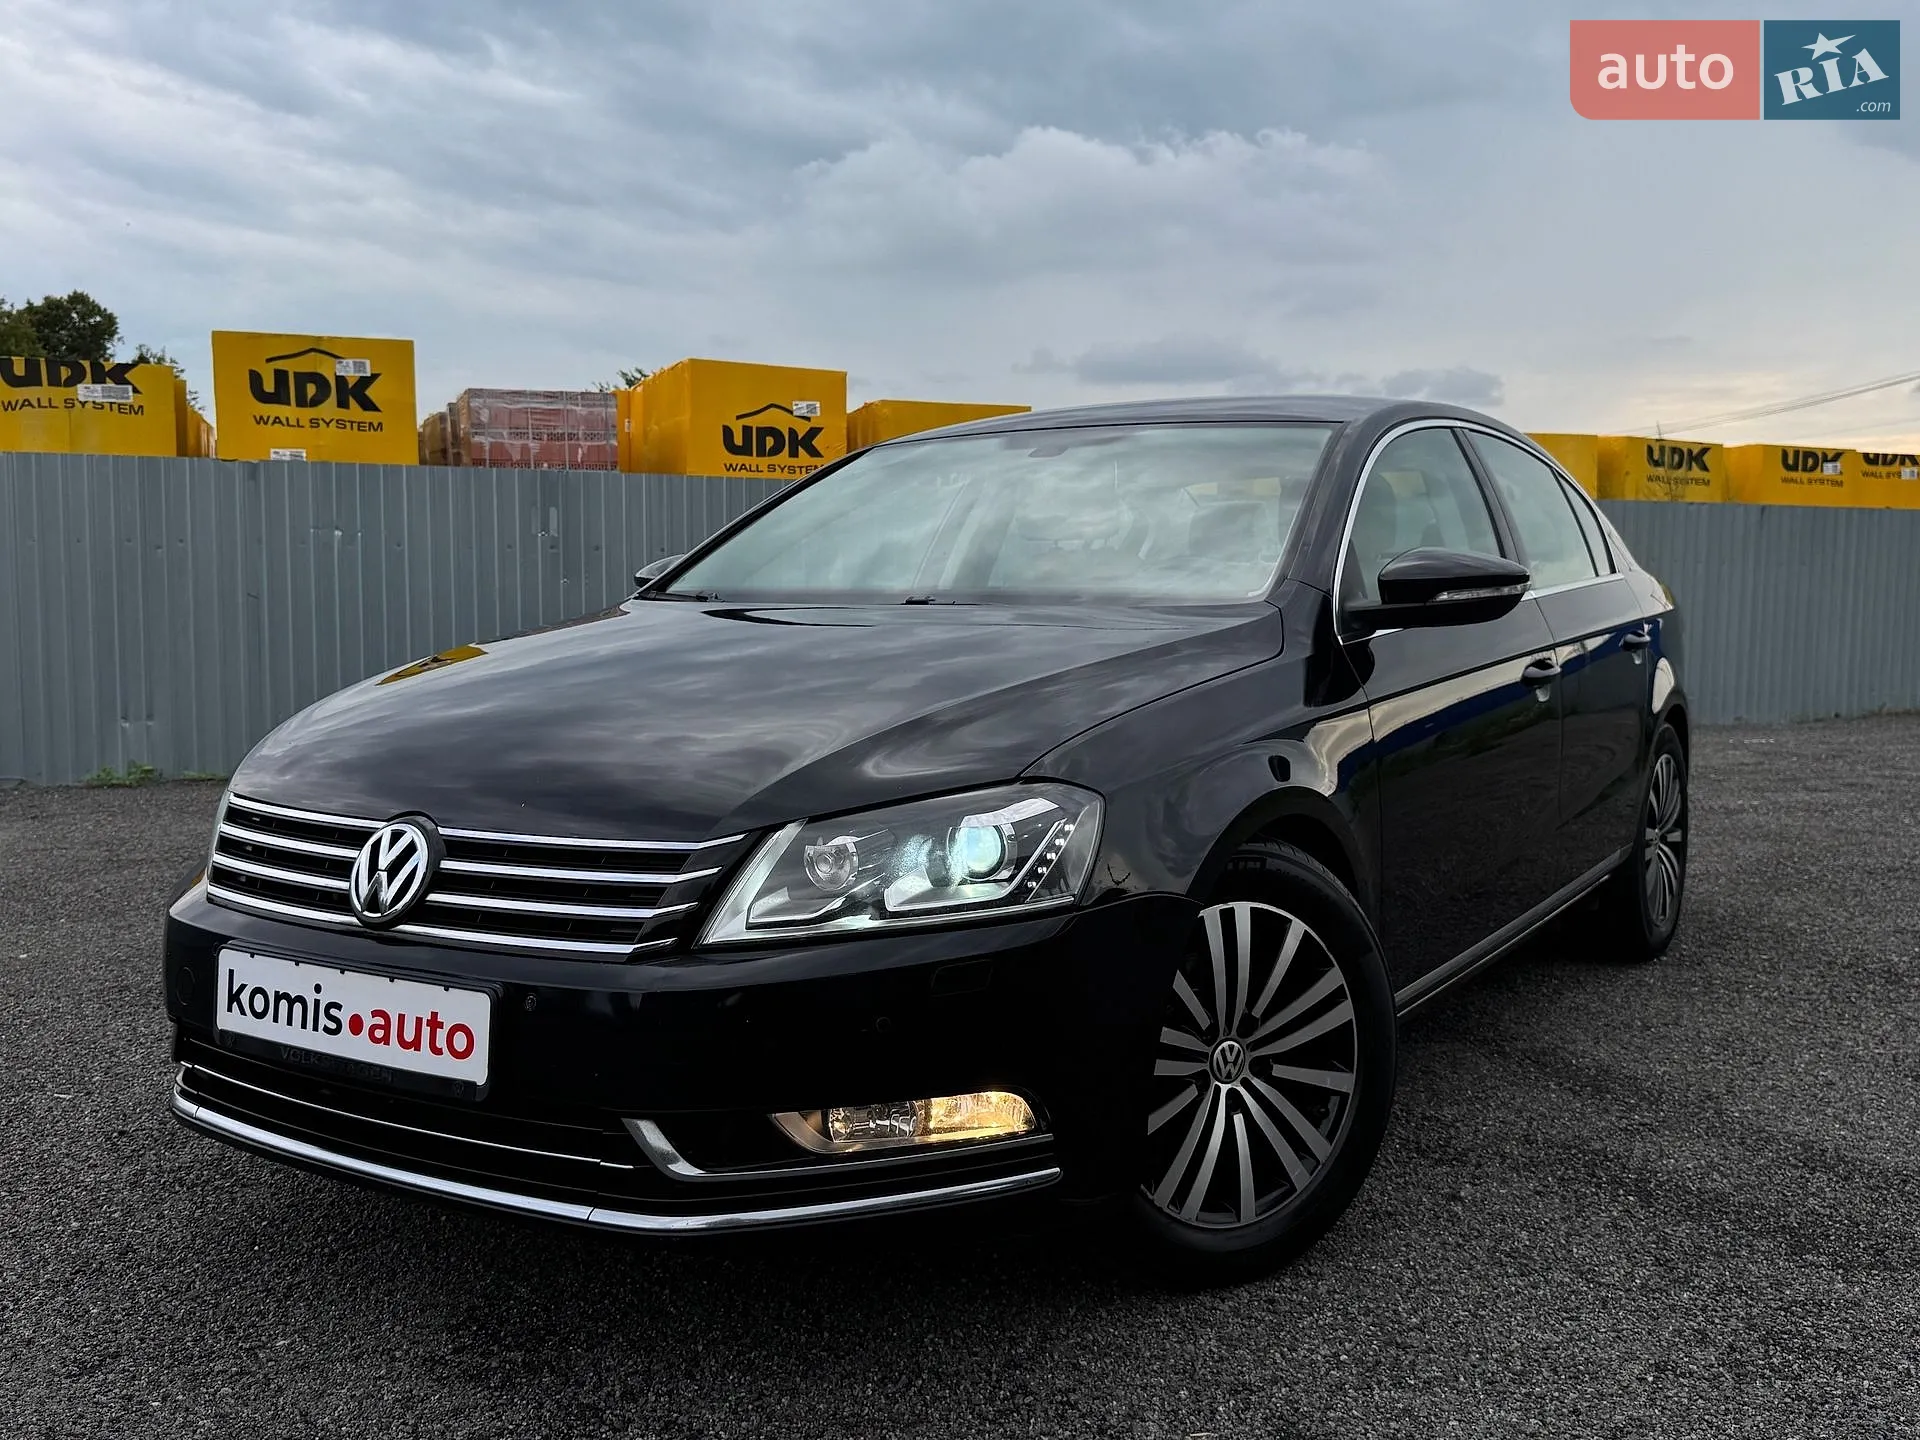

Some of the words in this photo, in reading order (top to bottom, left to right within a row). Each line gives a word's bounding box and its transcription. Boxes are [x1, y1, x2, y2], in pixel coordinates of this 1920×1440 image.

[0, 356, 143, 395] UDK
[248, 368, 383, 412] UDK
[2, 398, 58, 412] WALL
[64, 398, 144, 415] SYSTEM
[253, 415, 304, 428] WALL
[309, 418, 383, 432] SYSTEM
[722, 424, 824, 458] UDK
[1646, 444, 1712, 472] UDK
[724, 463, 764, 473] WALL
[1647, 474, 1672, 485] WALL
[1781, 475, 1805, 486] WALL
[1808, 477, 1843, 488] SYSTEM
